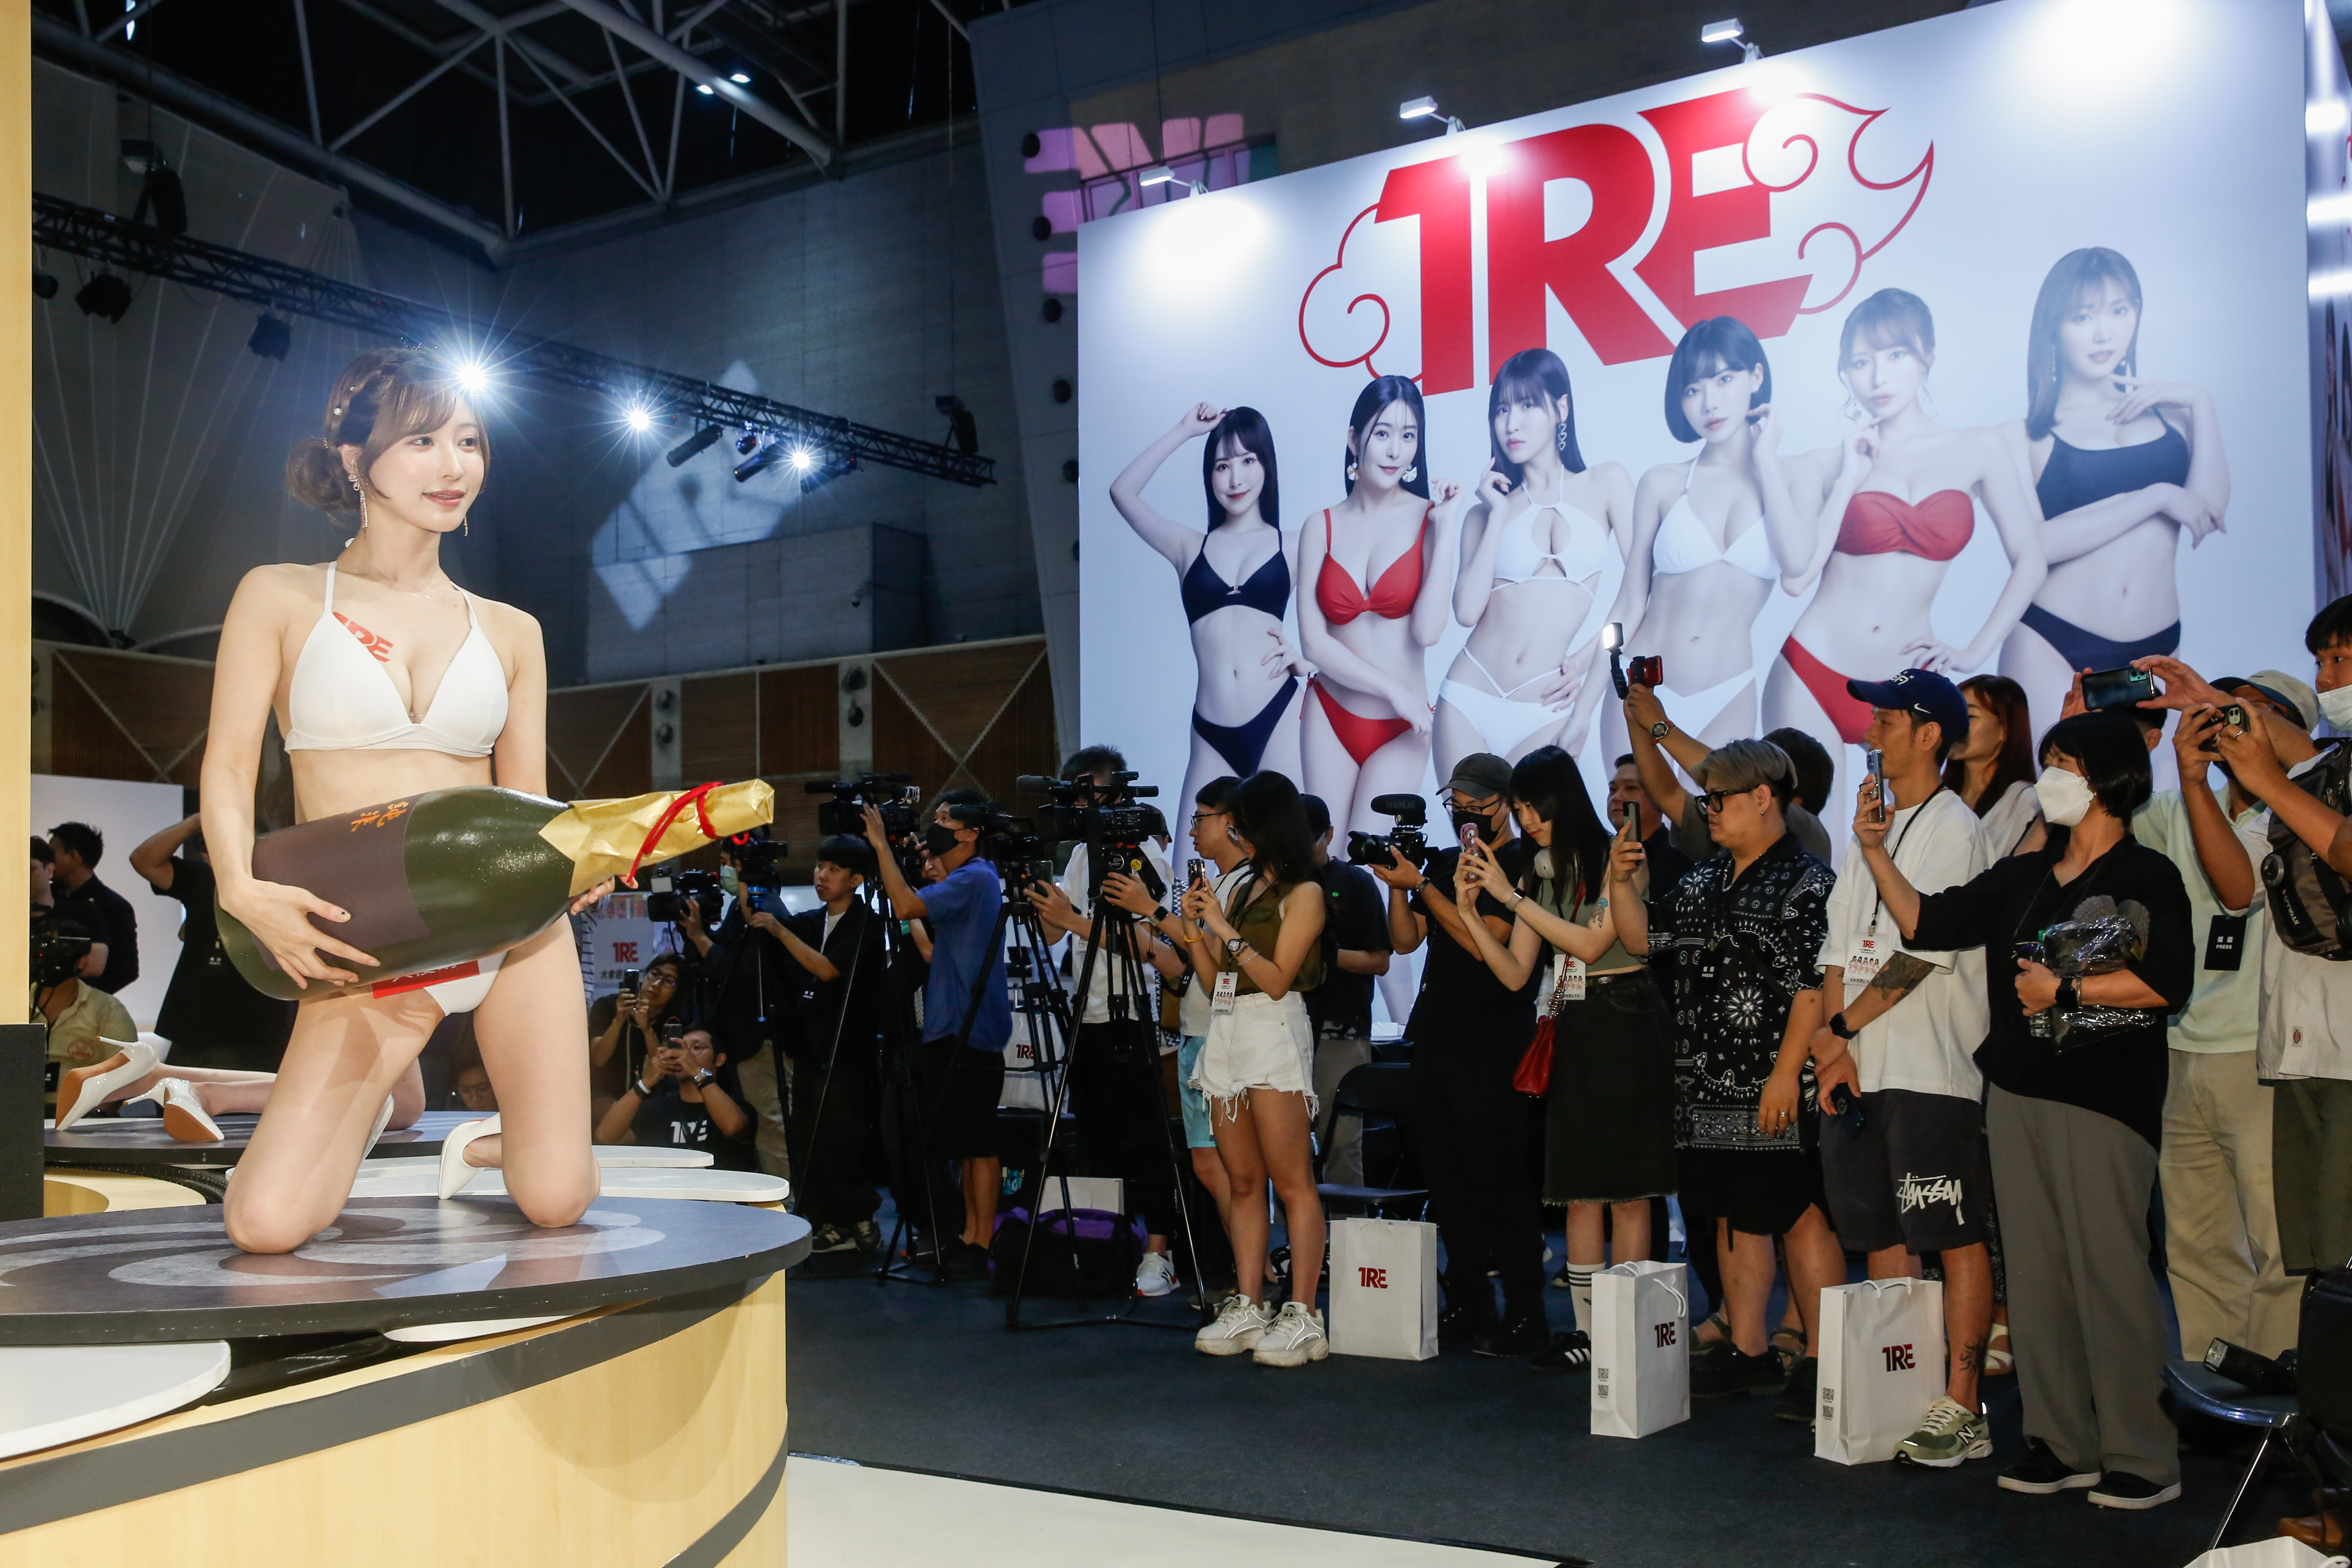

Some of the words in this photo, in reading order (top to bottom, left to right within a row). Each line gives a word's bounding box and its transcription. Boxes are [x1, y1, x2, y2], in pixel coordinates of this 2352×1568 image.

[1374, 87, 1813, 396] TRE
[613, 942, 639, 962] TRE
[1863, 940, 1874, 948] TRE
[1358, 1267, 1388, 1289] TRE
[1654, 1321, 1676, 1348] TRE
[1882, 1343, 1916, 1372] TRE
[1956, 1423, 1976, 1446] N
